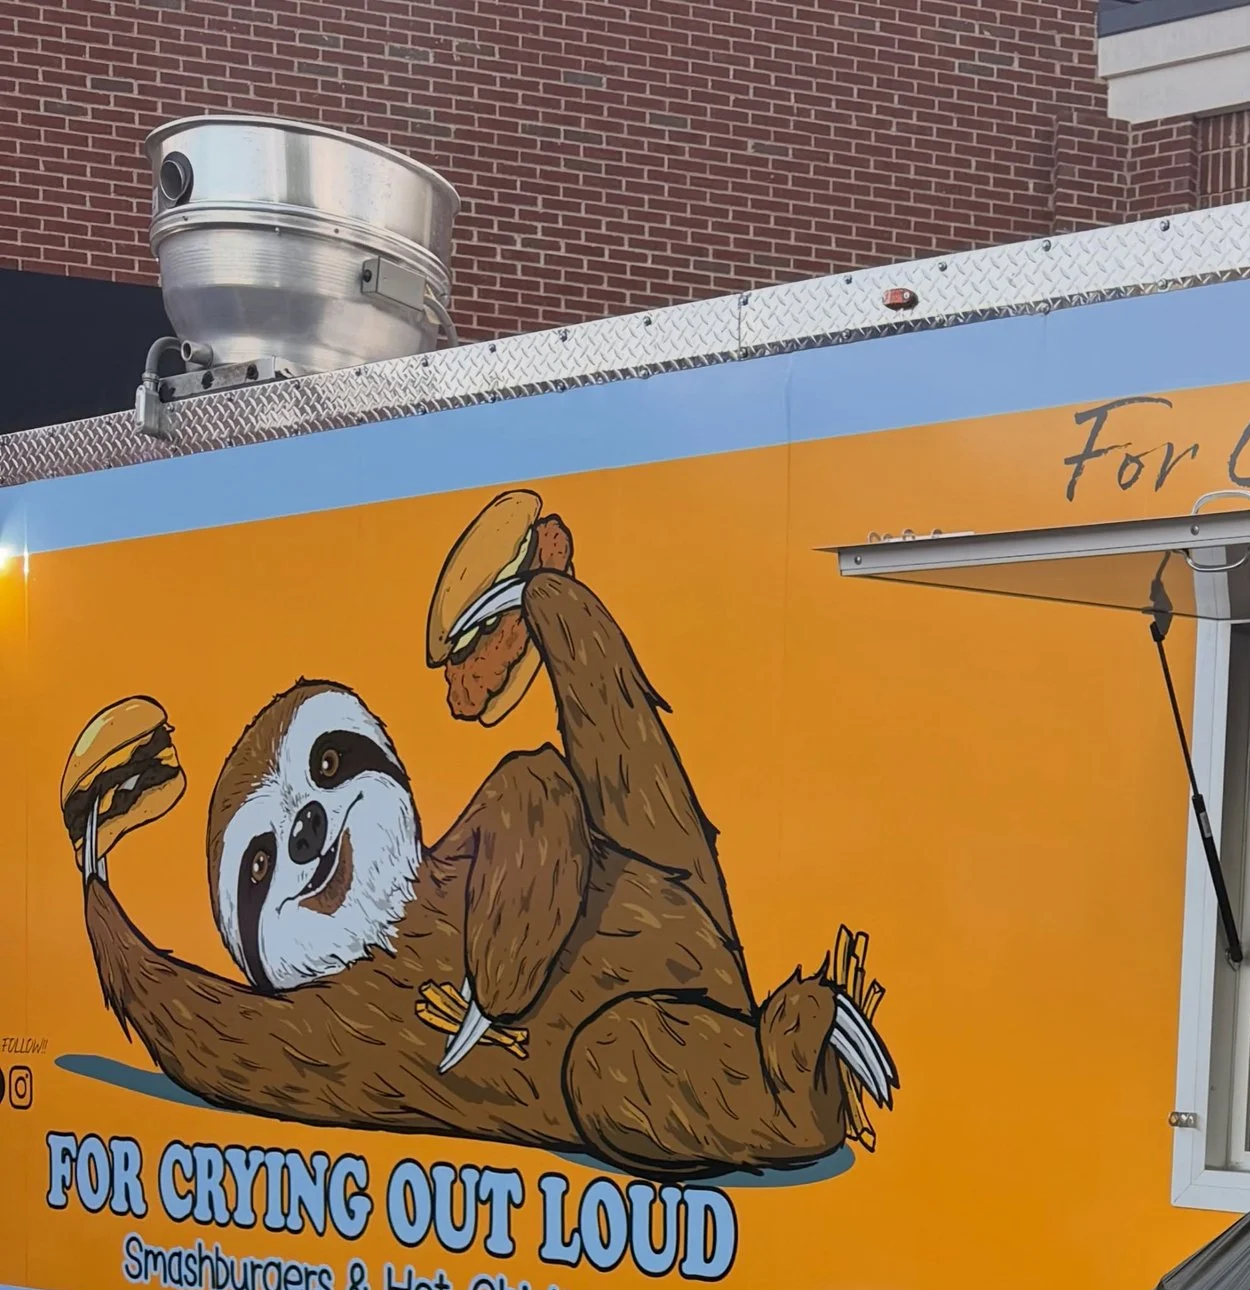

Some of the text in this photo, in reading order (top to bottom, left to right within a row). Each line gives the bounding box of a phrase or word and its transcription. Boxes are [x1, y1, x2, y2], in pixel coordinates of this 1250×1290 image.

[1065, 395, 1198, 502] For
[45, 1131, 739, 1283] FOR CRYING OUT LOUD
